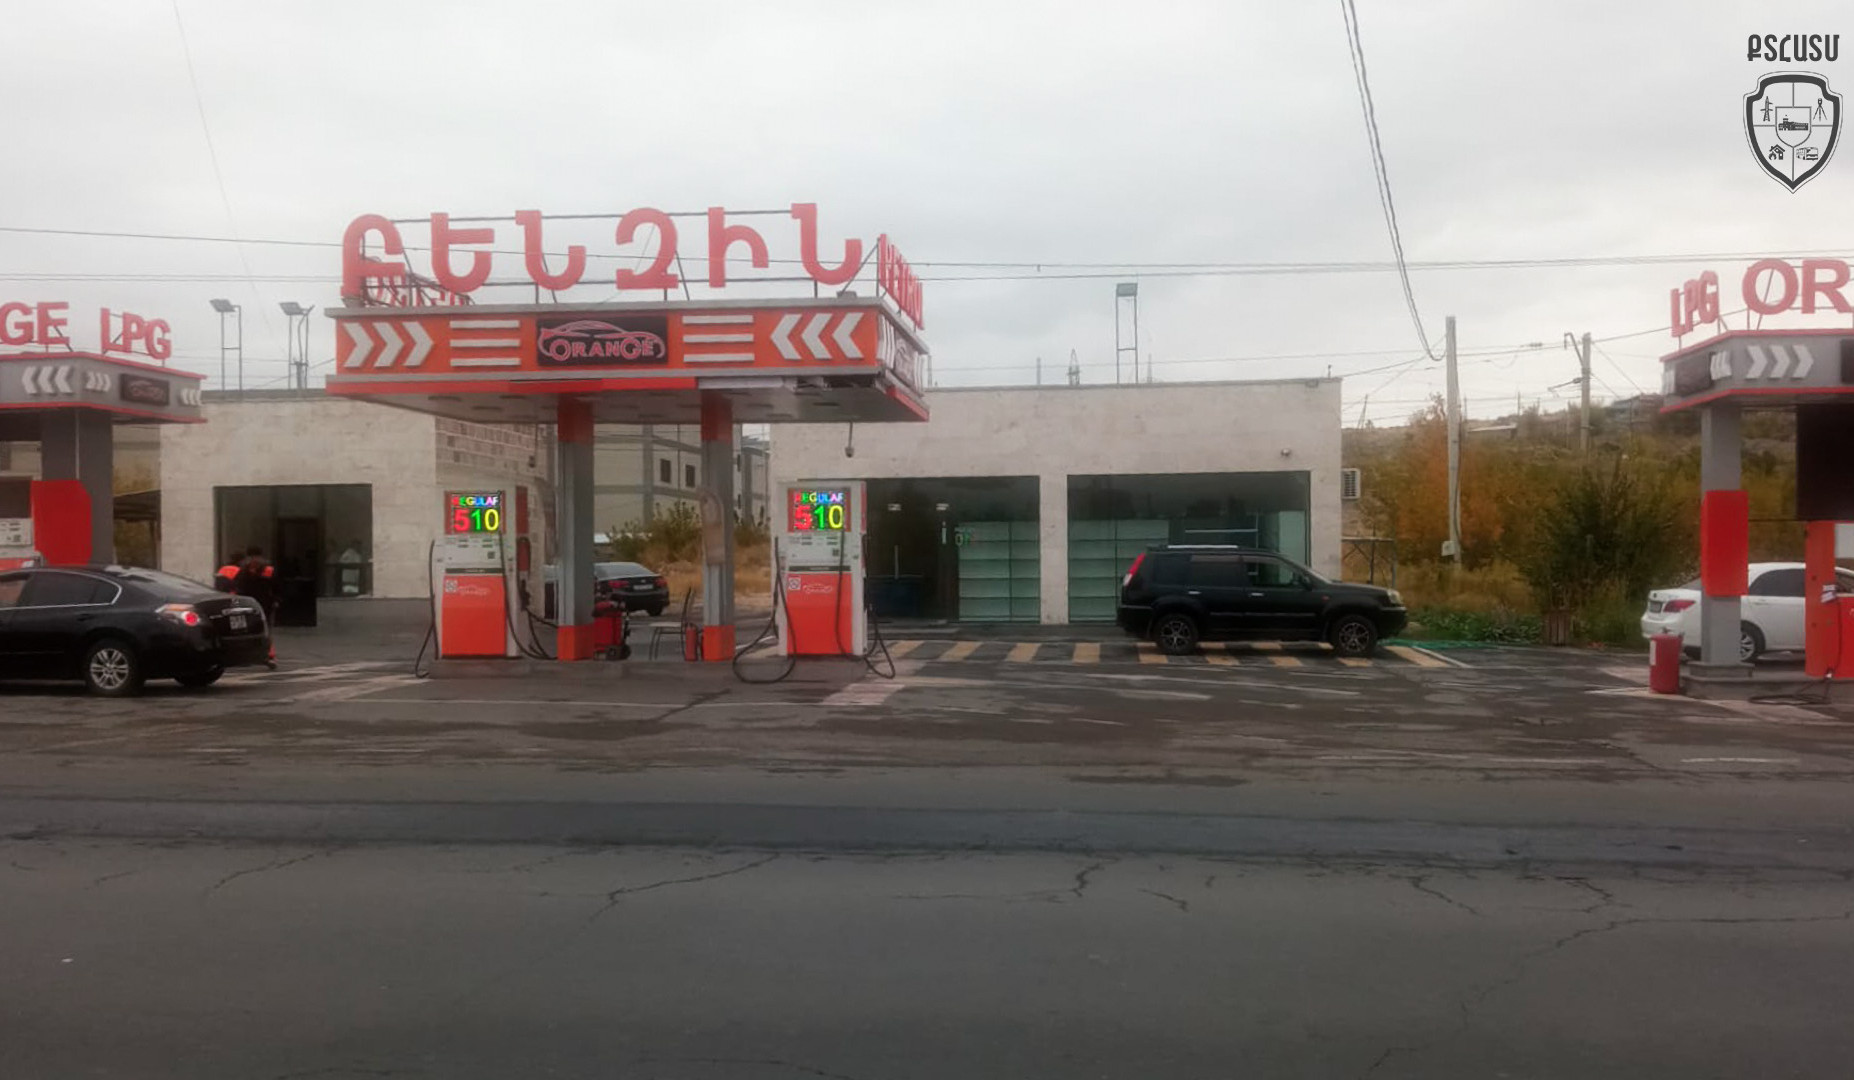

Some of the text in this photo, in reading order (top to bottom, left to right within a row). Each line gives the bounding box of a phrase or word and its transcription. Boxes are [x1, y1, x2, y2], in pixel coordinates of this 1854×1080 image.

[340, 203, 863, 297] ԲԵՆԶԻՆ
[1671, 258, 1854, 338] LPG OR
[100, 307, 172, 361] LPG
[549, 337, 655, 361] ORANGE
[453, 508, 499, 531] 510
[794, 504, 843, 530] 510
